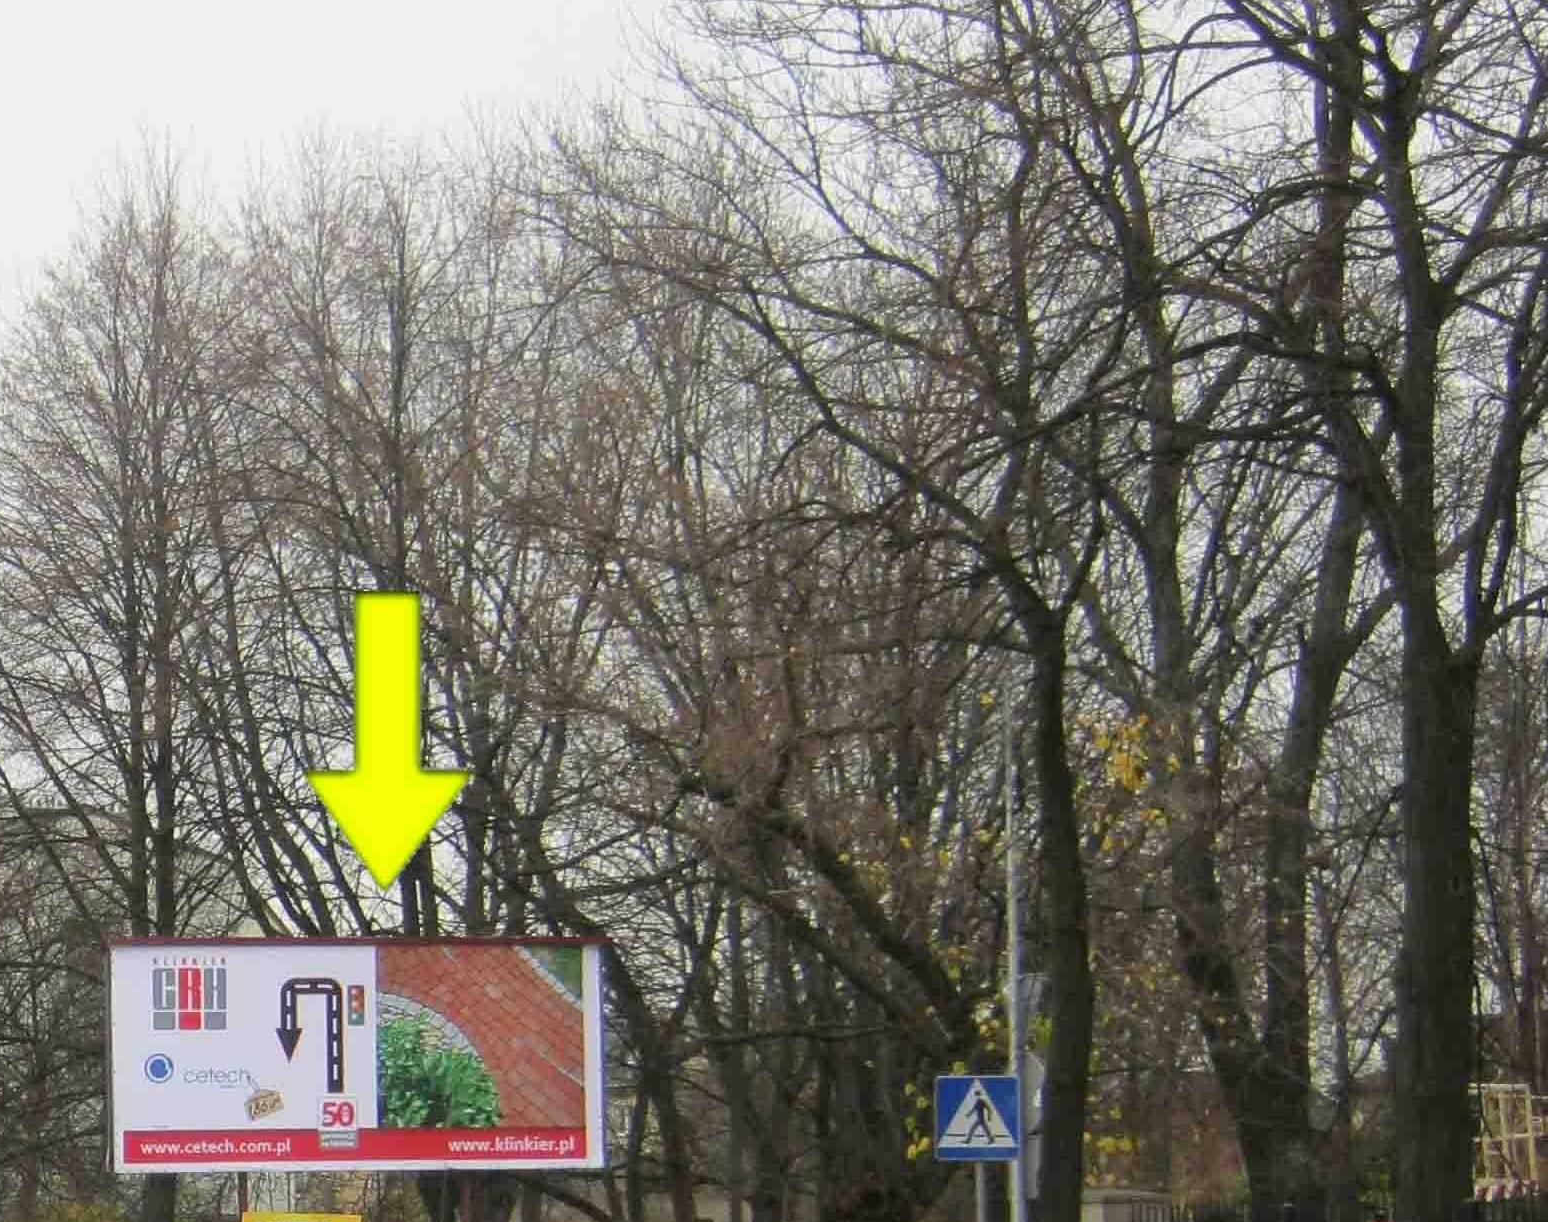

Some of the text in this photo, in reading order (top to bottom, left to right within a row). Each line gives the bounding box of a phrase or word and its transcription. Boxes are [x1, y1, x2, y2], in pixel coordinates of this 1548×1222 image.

[183, 1067, 251, 1084] cetech
[322, 1101, 355, 1127] 50
[139, 1138, 291, 1156] www.cetech.com.pl
[448, 1135, 575, 1155] www.klinkier.pl
